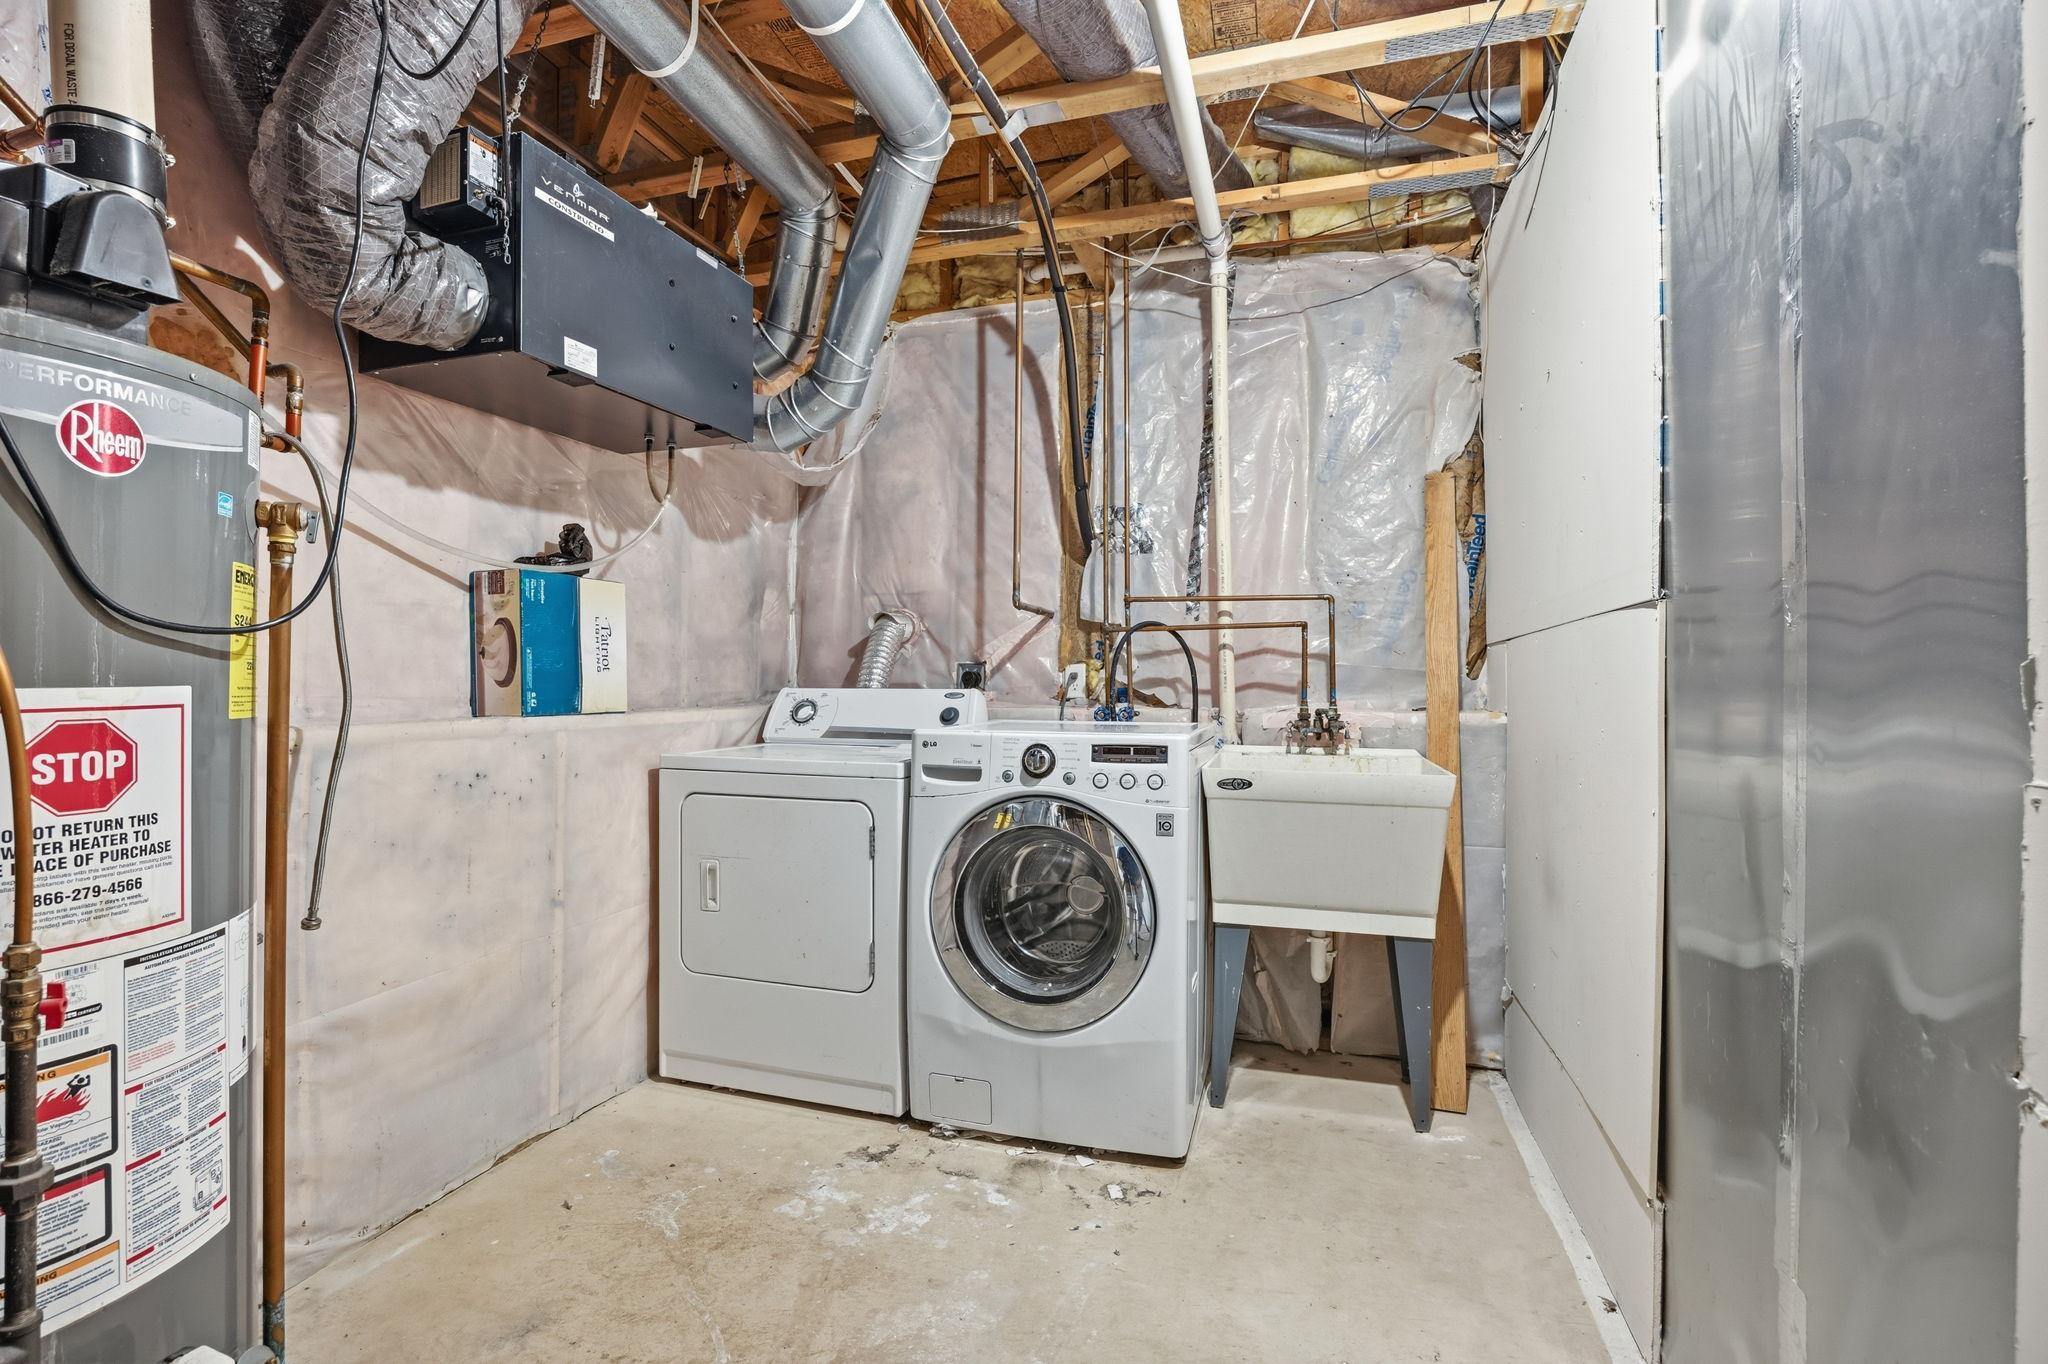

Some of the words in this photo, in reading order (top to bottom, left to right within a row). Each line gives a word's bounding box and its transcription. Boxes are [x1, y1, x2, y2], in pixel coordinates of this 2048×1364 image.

[64, 23, 75, 41] FOR
[64, 42, 77, 67] DRAIN
[66, 69, 78, 98] WASTE
[547, 197, 605, 235] CONSTRUCTO
[71, 402, 141, 464] Rheem
[601, 617, 612, 671] Patriot
[31, 749, 127, 786] STOP
[33, 825, 56, 840] OT
[62, 817, 124, 837] RETURN
[129, 812, 158, 828] THIS
[0, 841, 63, 860] WTER
[70, 832, 128, 851] HEATER
[133, 829, 150, 843] TO
[74, 852, 94, 868] OF
[100, 840, 172, 864] PURCHASE
